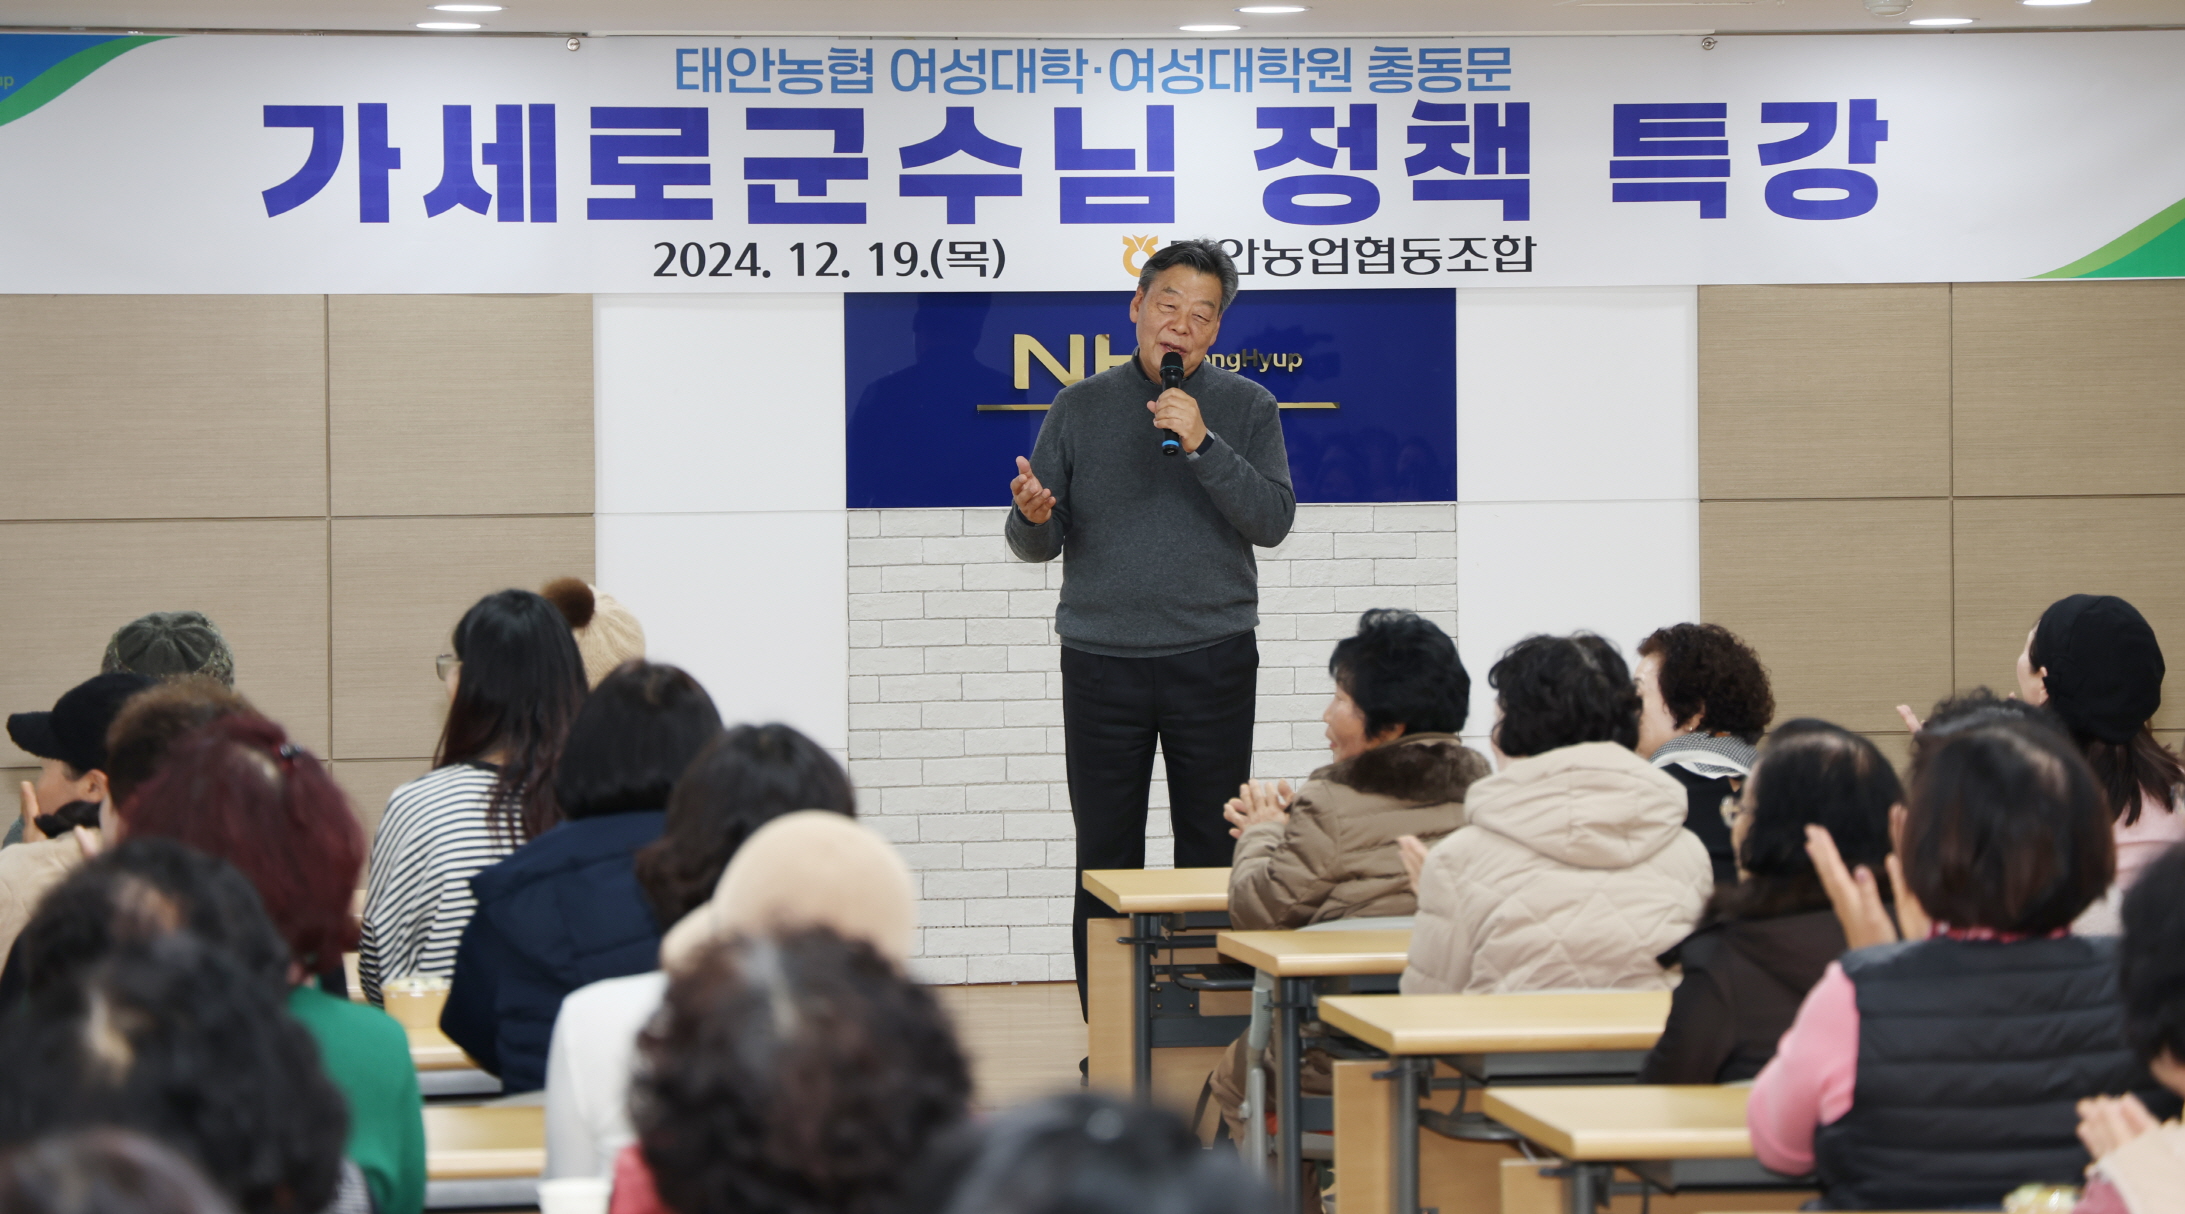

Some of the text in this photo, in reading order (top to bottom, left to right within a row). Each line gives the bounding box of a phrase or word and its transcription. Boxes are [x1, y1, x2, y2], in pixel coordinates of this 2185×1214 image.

[676, 45, 1512, 96] 태안농협 여성대학·여성대학원 총동문
[261, 98, 1889, 226] 가세로군수님 정책 특강
[653, 238, 1006, 279] 2024. 12. 19.(목)
[1171, 234, 1538, 277] 안농업협동조합
